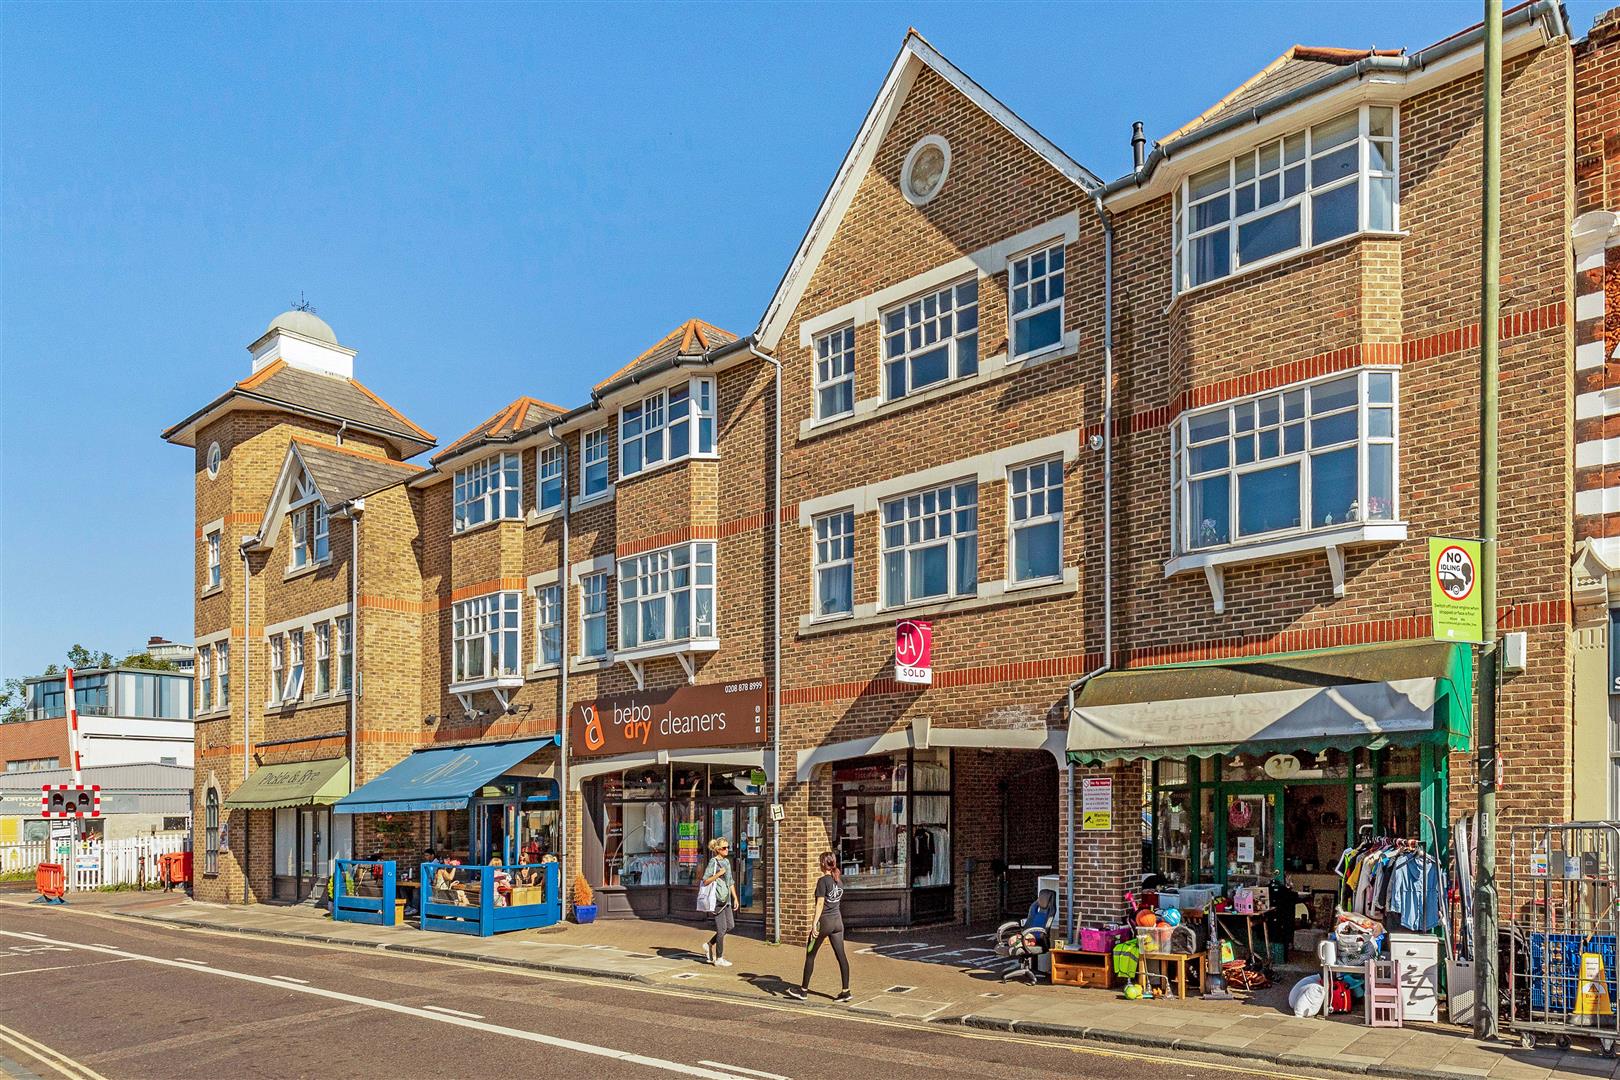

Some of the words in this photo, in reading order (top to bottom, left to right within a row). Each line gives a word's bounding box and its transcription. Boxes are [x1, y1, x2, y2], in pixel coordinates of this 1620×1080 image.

[1446, 552, 1462, 564] NO
[1440, 563, 1461, 572] IDLING
[903, 668, 926, 678] SOLD
[724, 684, 738, 694] 0208
[738, 683, 748, 692] 878
[750, 681, 763, 691] 8999
[614, 700, 651, 726] bebo
[624, 717, 652, 745] dry
[660, 710, 726, 736] cleaners
[258, 771, 290, 785] Pickle
[288, 771, 301, 784] &
[298, 769, 321, 786] Rye
[772, 806, 783, 824] H
